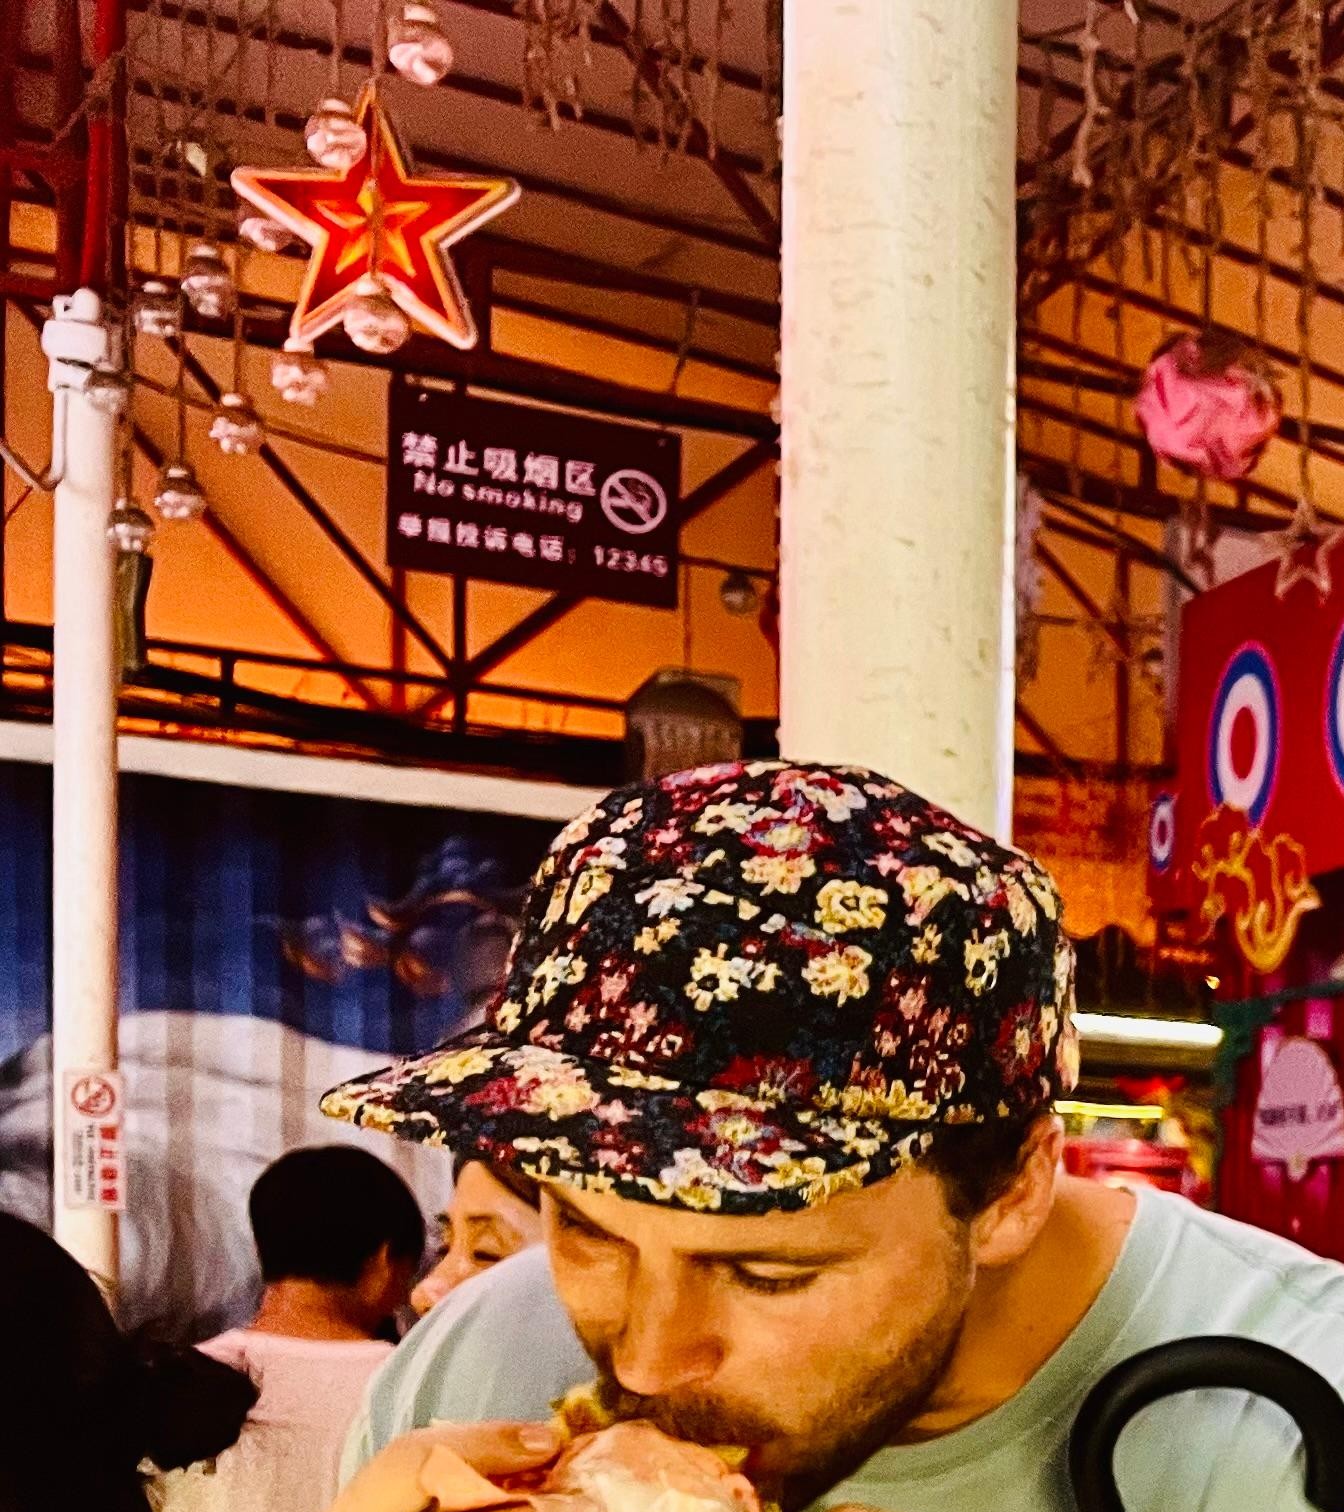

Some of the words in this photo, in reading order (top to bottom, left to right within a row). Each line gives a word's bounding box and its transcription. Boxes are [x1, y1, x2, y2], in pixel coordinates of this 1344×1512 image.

[402, 431, 597, 496] 禁止吸烟区
[413, 470, 456, 496] No
[461, 480, 583, 523] smoking
